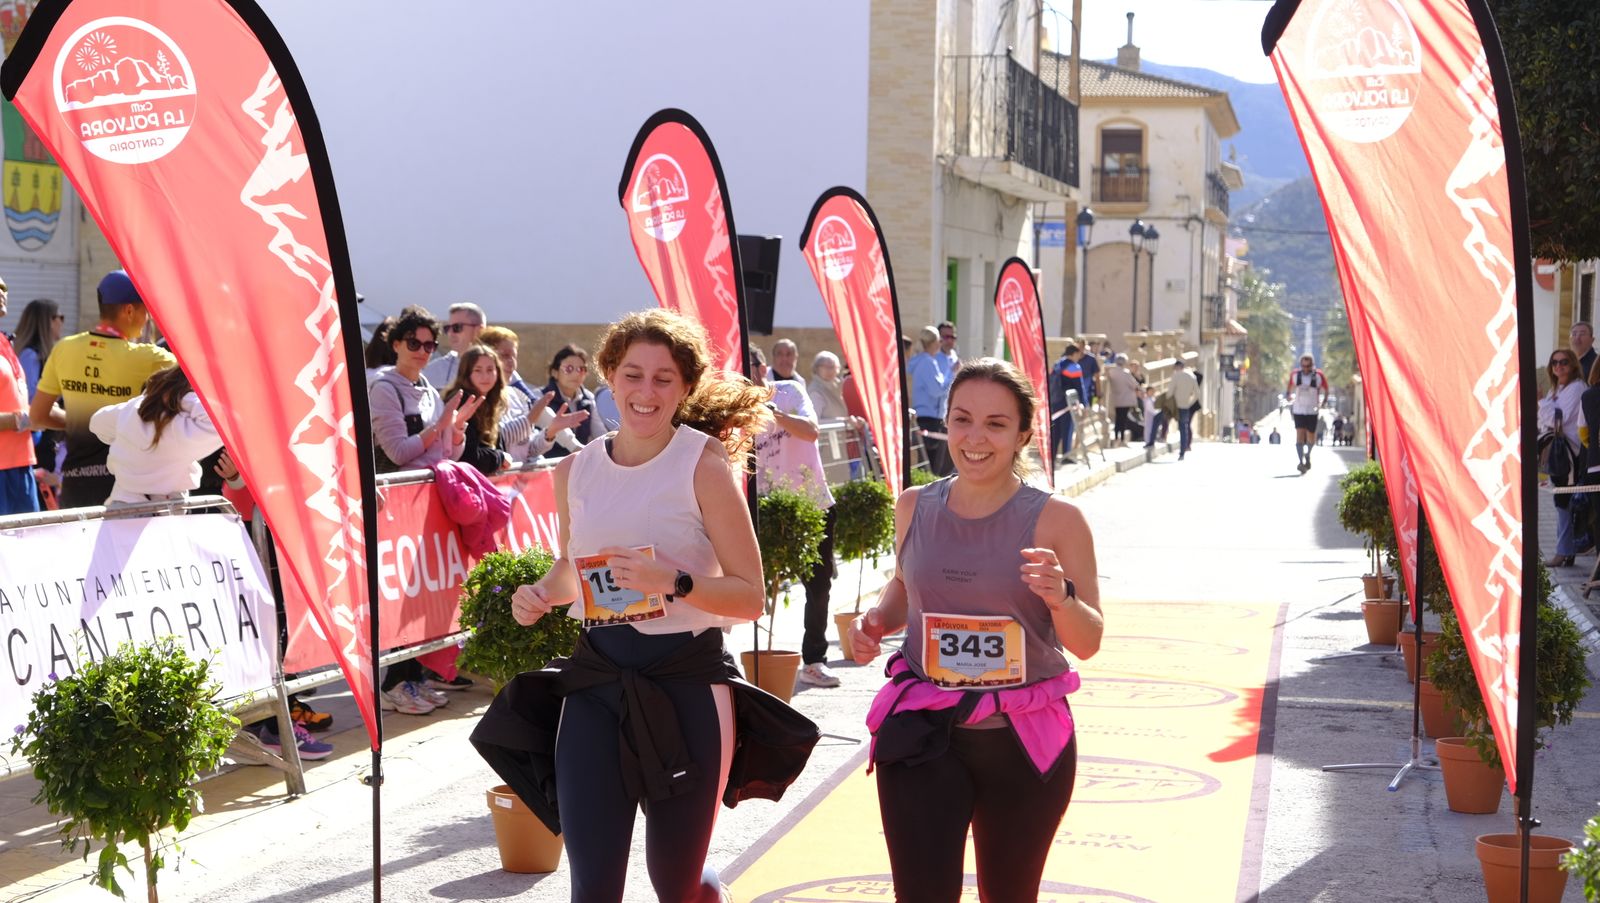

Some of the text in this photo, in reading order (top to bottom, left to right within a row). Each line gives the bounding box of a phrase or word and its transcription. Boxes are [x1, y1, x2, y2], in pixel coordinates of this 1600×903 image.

[90, 382, 132, 397] ENMEDIO
[377, 529, 468, 601] EOLIA
[589, 570, 621, 593] 19
[0, 558, 244, 614] AYUNTAMIENTO DE
[7, 593, 259, 686] CANTORIA
[940, 633, 1005, 658] 343
